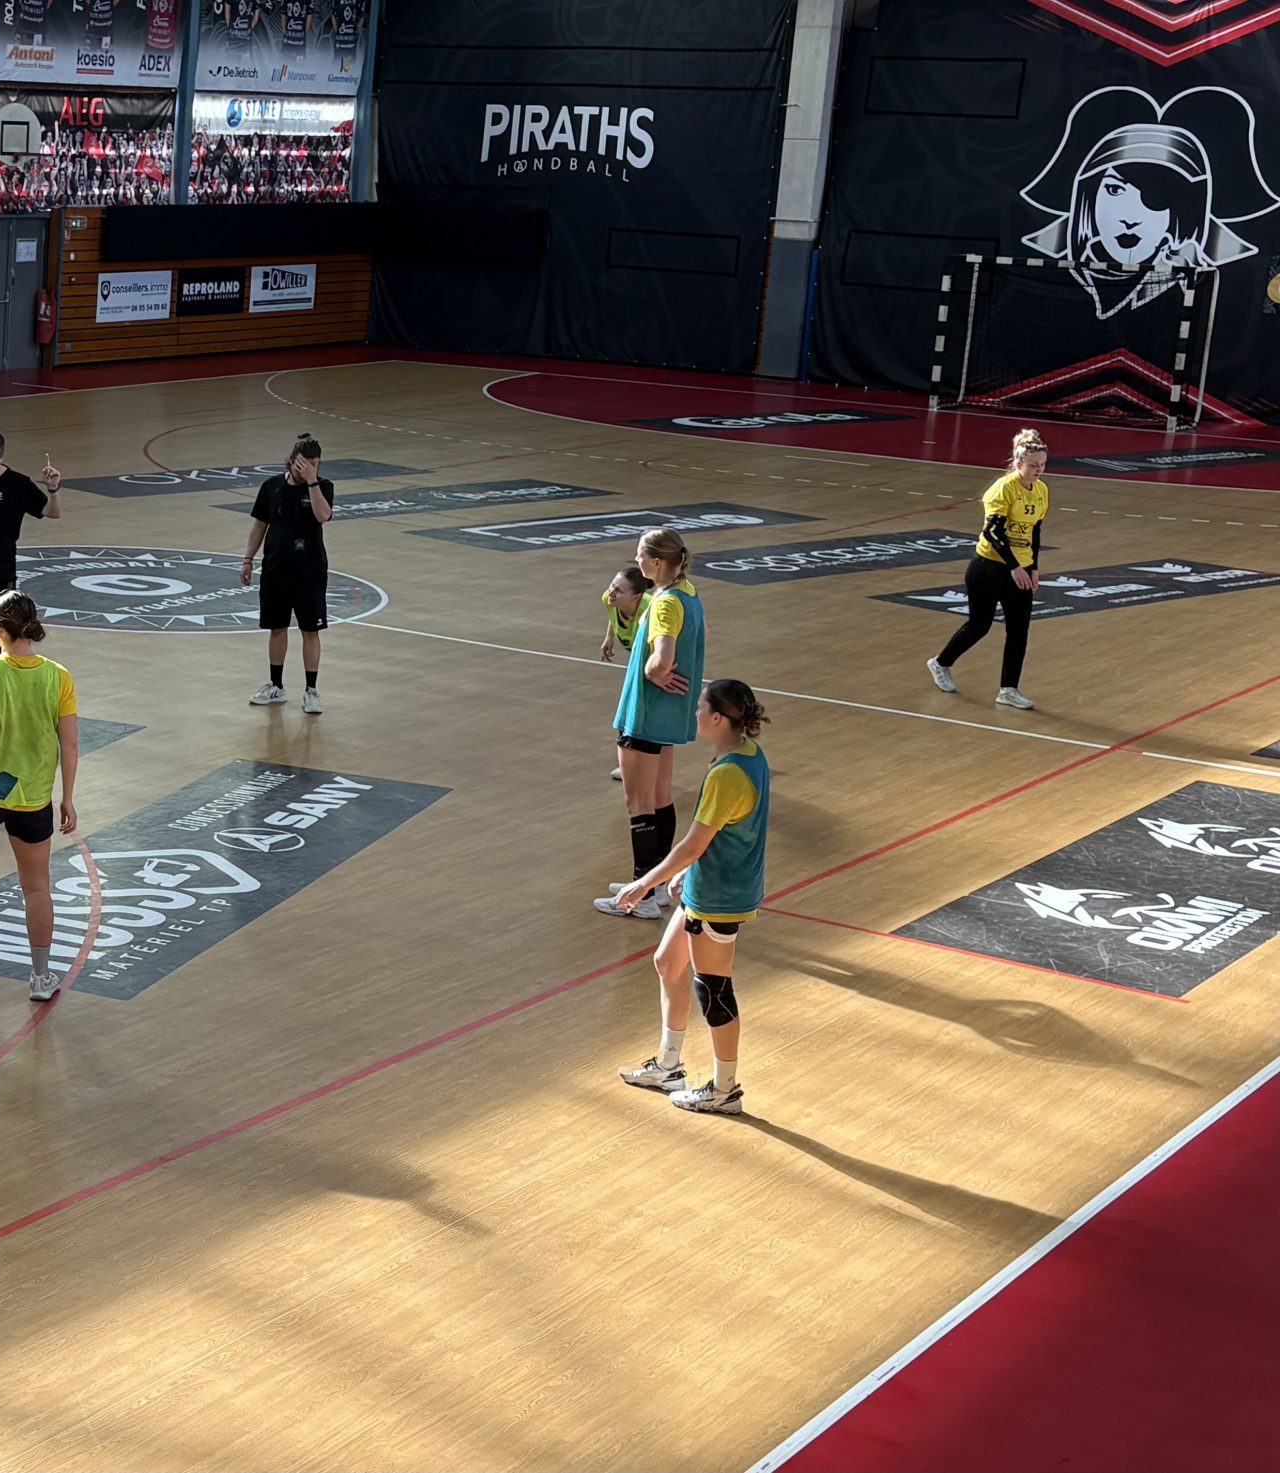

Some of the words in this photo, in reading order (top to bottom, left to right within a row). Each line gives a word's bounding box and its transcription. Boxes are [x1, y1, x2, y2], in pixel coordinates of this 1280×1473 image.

[77, 48, 115, 67] koesio
[138, 54, 171, 72] ADEX
[60, 96, 105, 127] AEG
[480, 103, 655, 169] PIRATHS
[182, 281, 240, 296] REPROLAND
[1024, 504, 1036, 515] 53
[115, 584, 260, 615] Truchtershe
[168, 771, 297, 832] CONCESSIONNAIRE
[263, 775, 374, 830] SANY
[89, 914, 206, 981] MATÉRIEL
[199, 897, 233, 913] TP
[1181, 908, 1272, 954] PROTECTION
